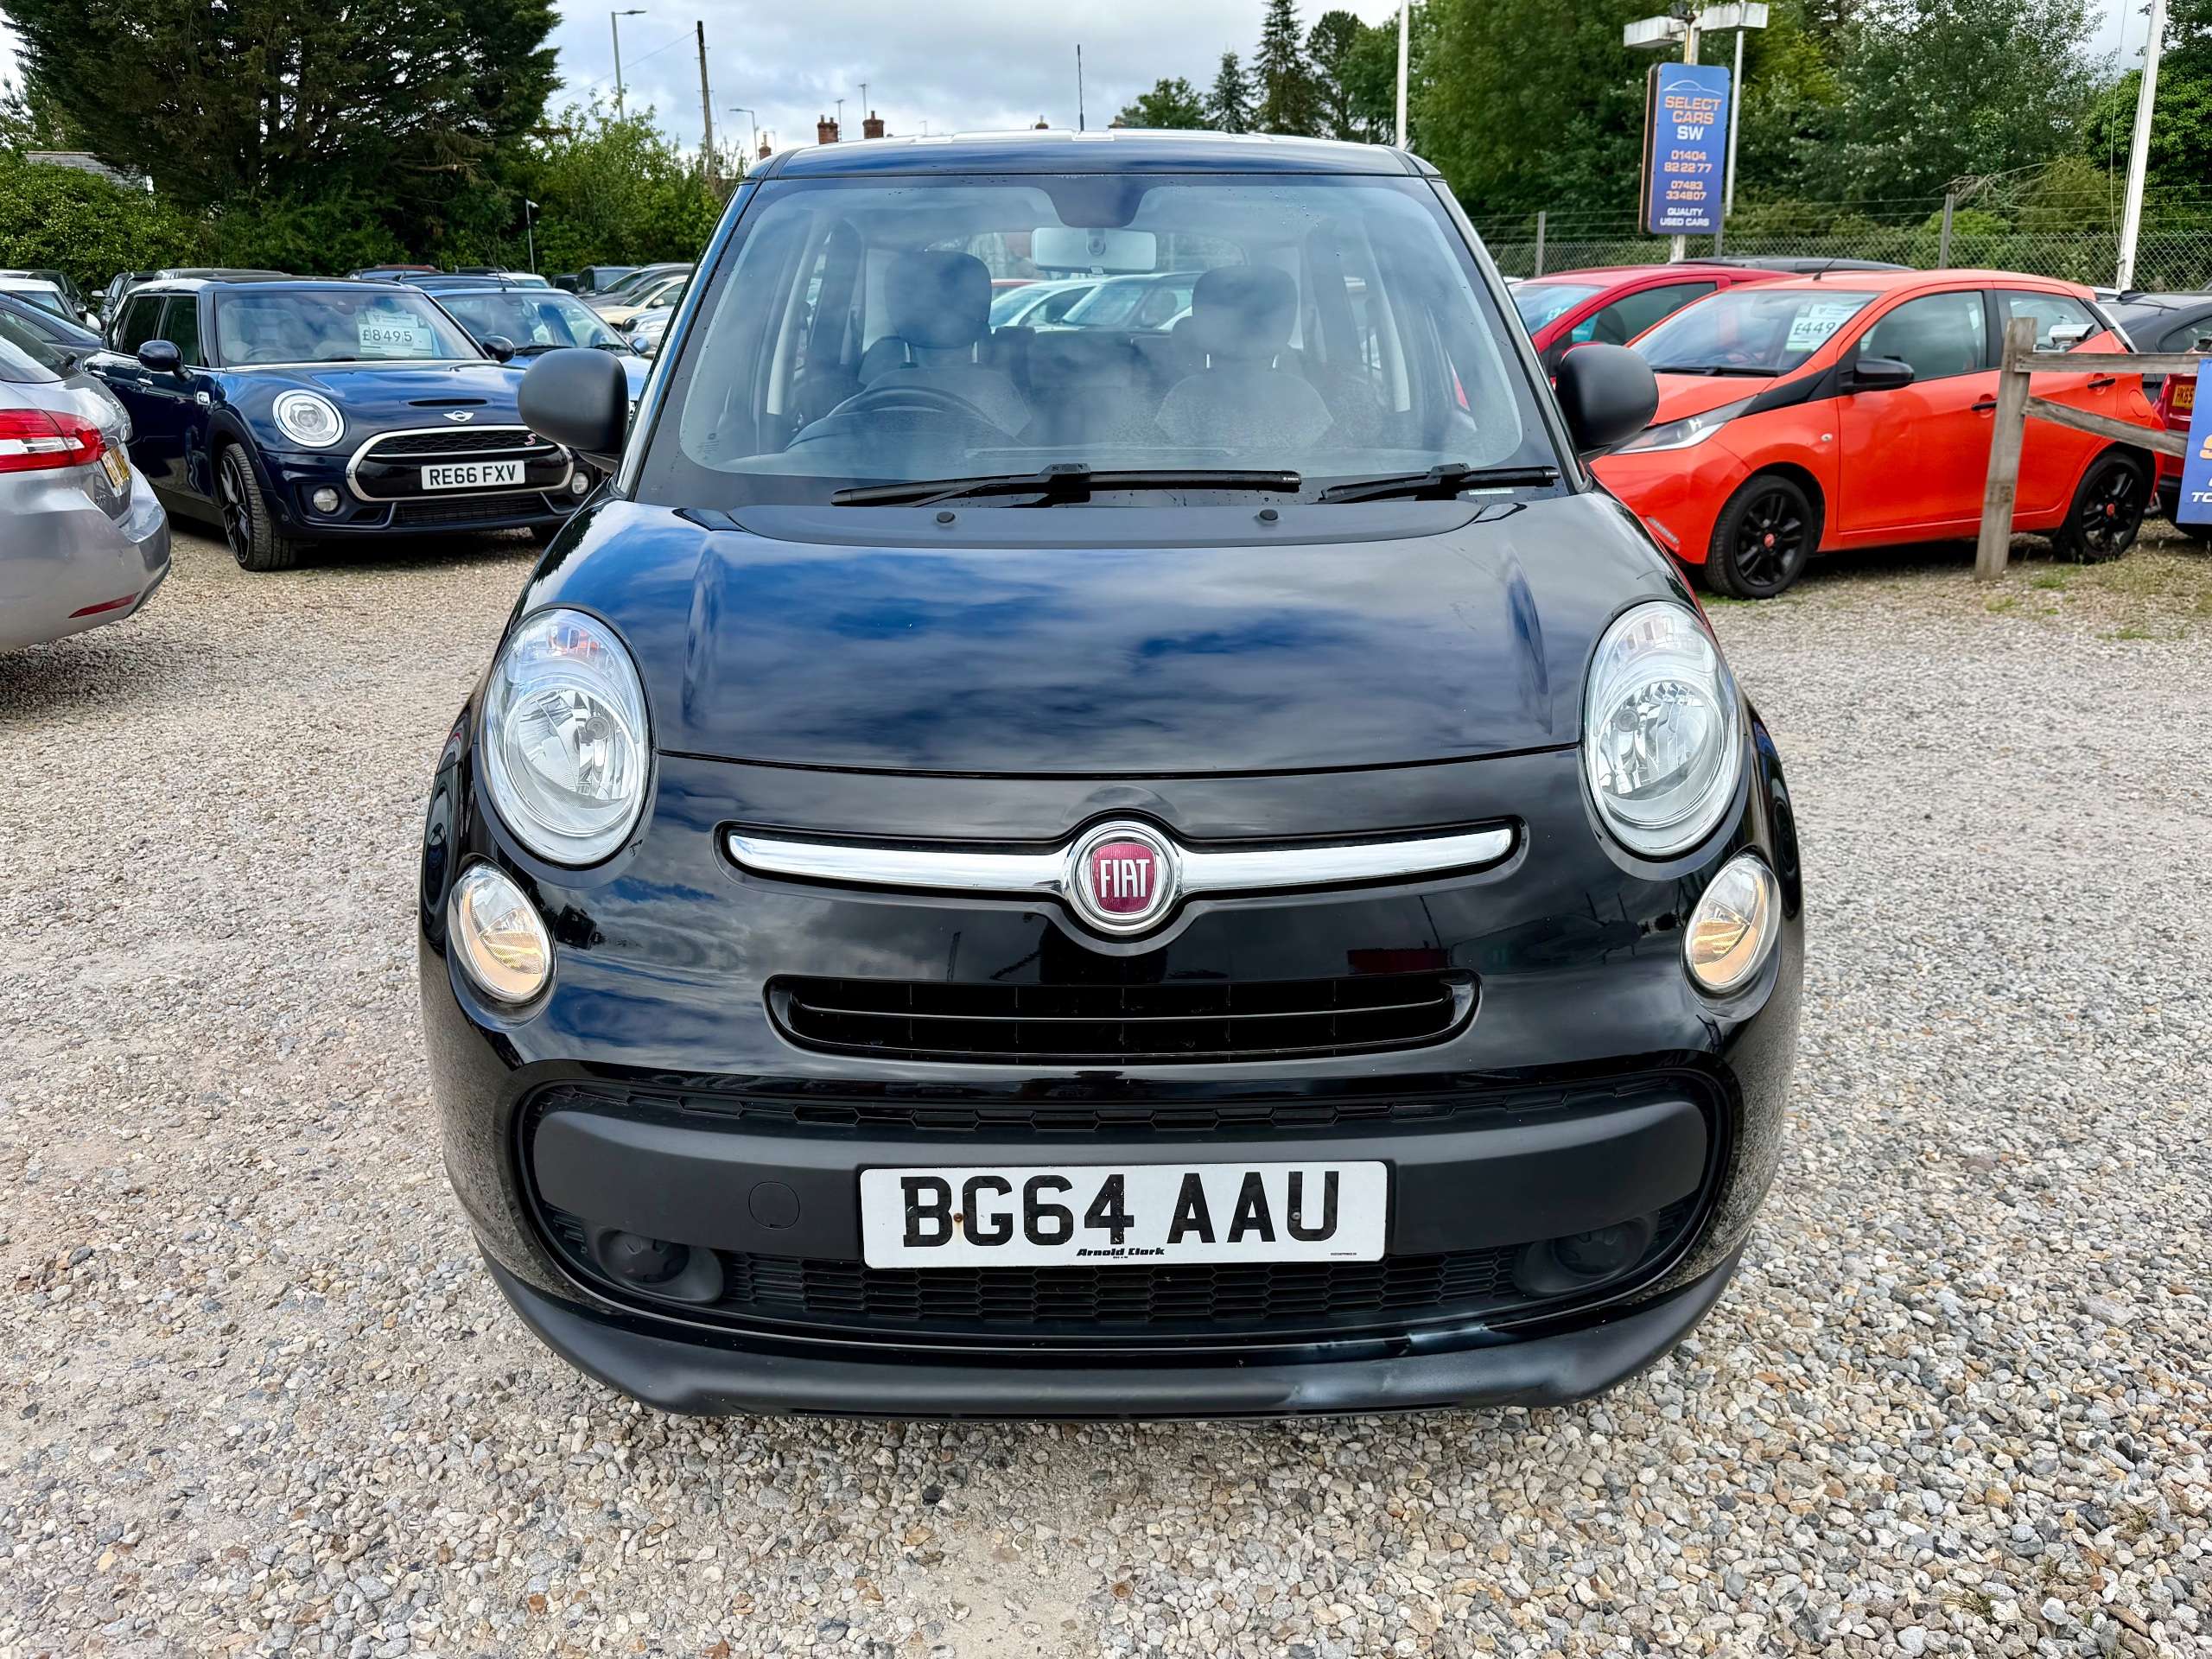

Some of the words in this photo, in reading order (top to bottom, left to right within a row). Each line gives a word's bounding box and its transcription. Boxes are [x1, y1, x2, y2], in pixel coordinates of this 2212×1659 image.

[1665, 96, 1721, 111] SELECT
[1673, 111, 1714, 124] CARS
[1677, 125, 1704, 140] SW
[1671, 149, 1707, 161] 01404
[1667, 207, 1704, 216] QUALITY
[1660, 217, 1684, 226] USED
[1685, 218, 1710, 226] CARS
[362, 328, 413, 342] £8495
[1793, 321, 1846, 335] £449
[429, 467, 477, 486] RE66
[482, 464, 516, 483] FXV
[1100, 859, 1150, 898] FIAT
[900, 1173, 1135, 1248] BG64
[1166, 1171, 1339, 1243] AAU
[1077, 1248, 1125, 1256] Arnold
[1128, 1247, 1165, 1255] Clark
